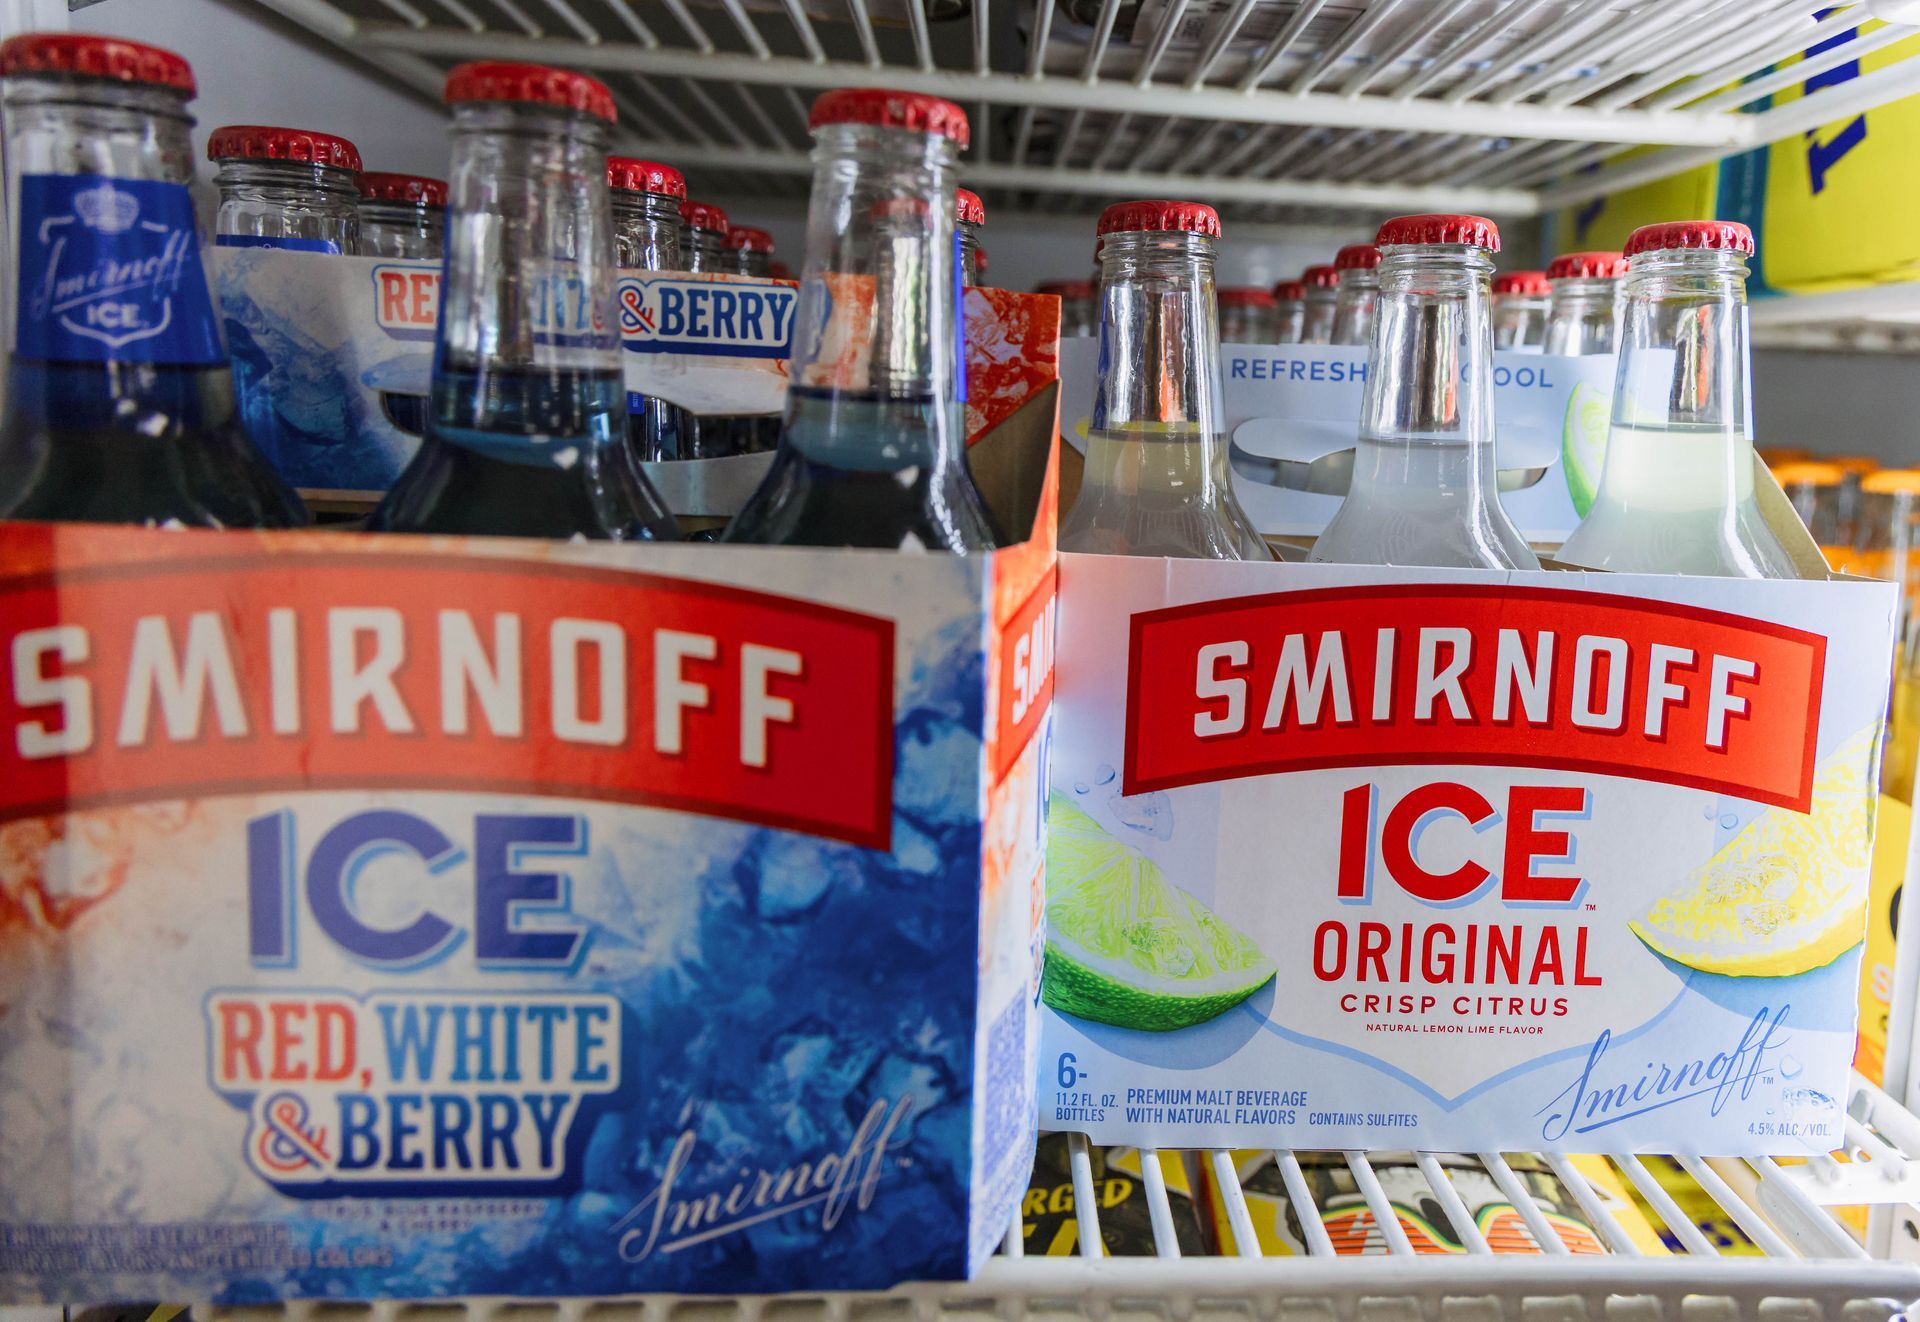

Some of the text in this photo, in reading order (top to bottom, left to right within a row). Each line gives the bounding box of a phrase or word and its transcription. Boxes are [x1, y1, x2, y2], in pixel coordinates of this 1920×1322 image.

[87, 302, 141, 328] ICE
[380, 272, 441, 325] RE
[618, 285, 656, 334] &
[658, 287, 793, 341] BERRY
[1231, 358, 1366, 383] REFRESH
[12, 607, 804, 768] SMIRNOFF
[1194, 627, 1761, 752] SMIRNOFF
[1337, 782, 1593, 910] ICE
[247, 808, 589, 974] ICE
[1312, 920, 1603, 986] ORIGINAL
[1340, 994, 1569, 1016] CRISP CITRUS
[217, 1001, 610, 1090] RED, WHITE
[1366, 1023, 1544, 1035] NATURAL LEMON LIME FLAVOR
[1058, 1052, 1088, 1089] 6-
[1532, 1003, 1793, 1141] Smirnoff
[1056, 1092, 1119, 1108] 11.2 FL. OZ.
[1056, 1107, 1105, 1122] BOTTLES
[1126, 1107, 1296, 1125] WITH NATURAL FLAVORS
[1127, 1088, 1308, 1107] PREMIUM MALT BEVERAGE
[258, 1090, 571, 1172] & BERRY
[1309, 1112, 1418, 1127] CONTAINS SULFITES
[1748, 1123, 1832, 1137] 4.5% ALC./VOL.
[608, 1097, 914, 1264] Smirnoff
